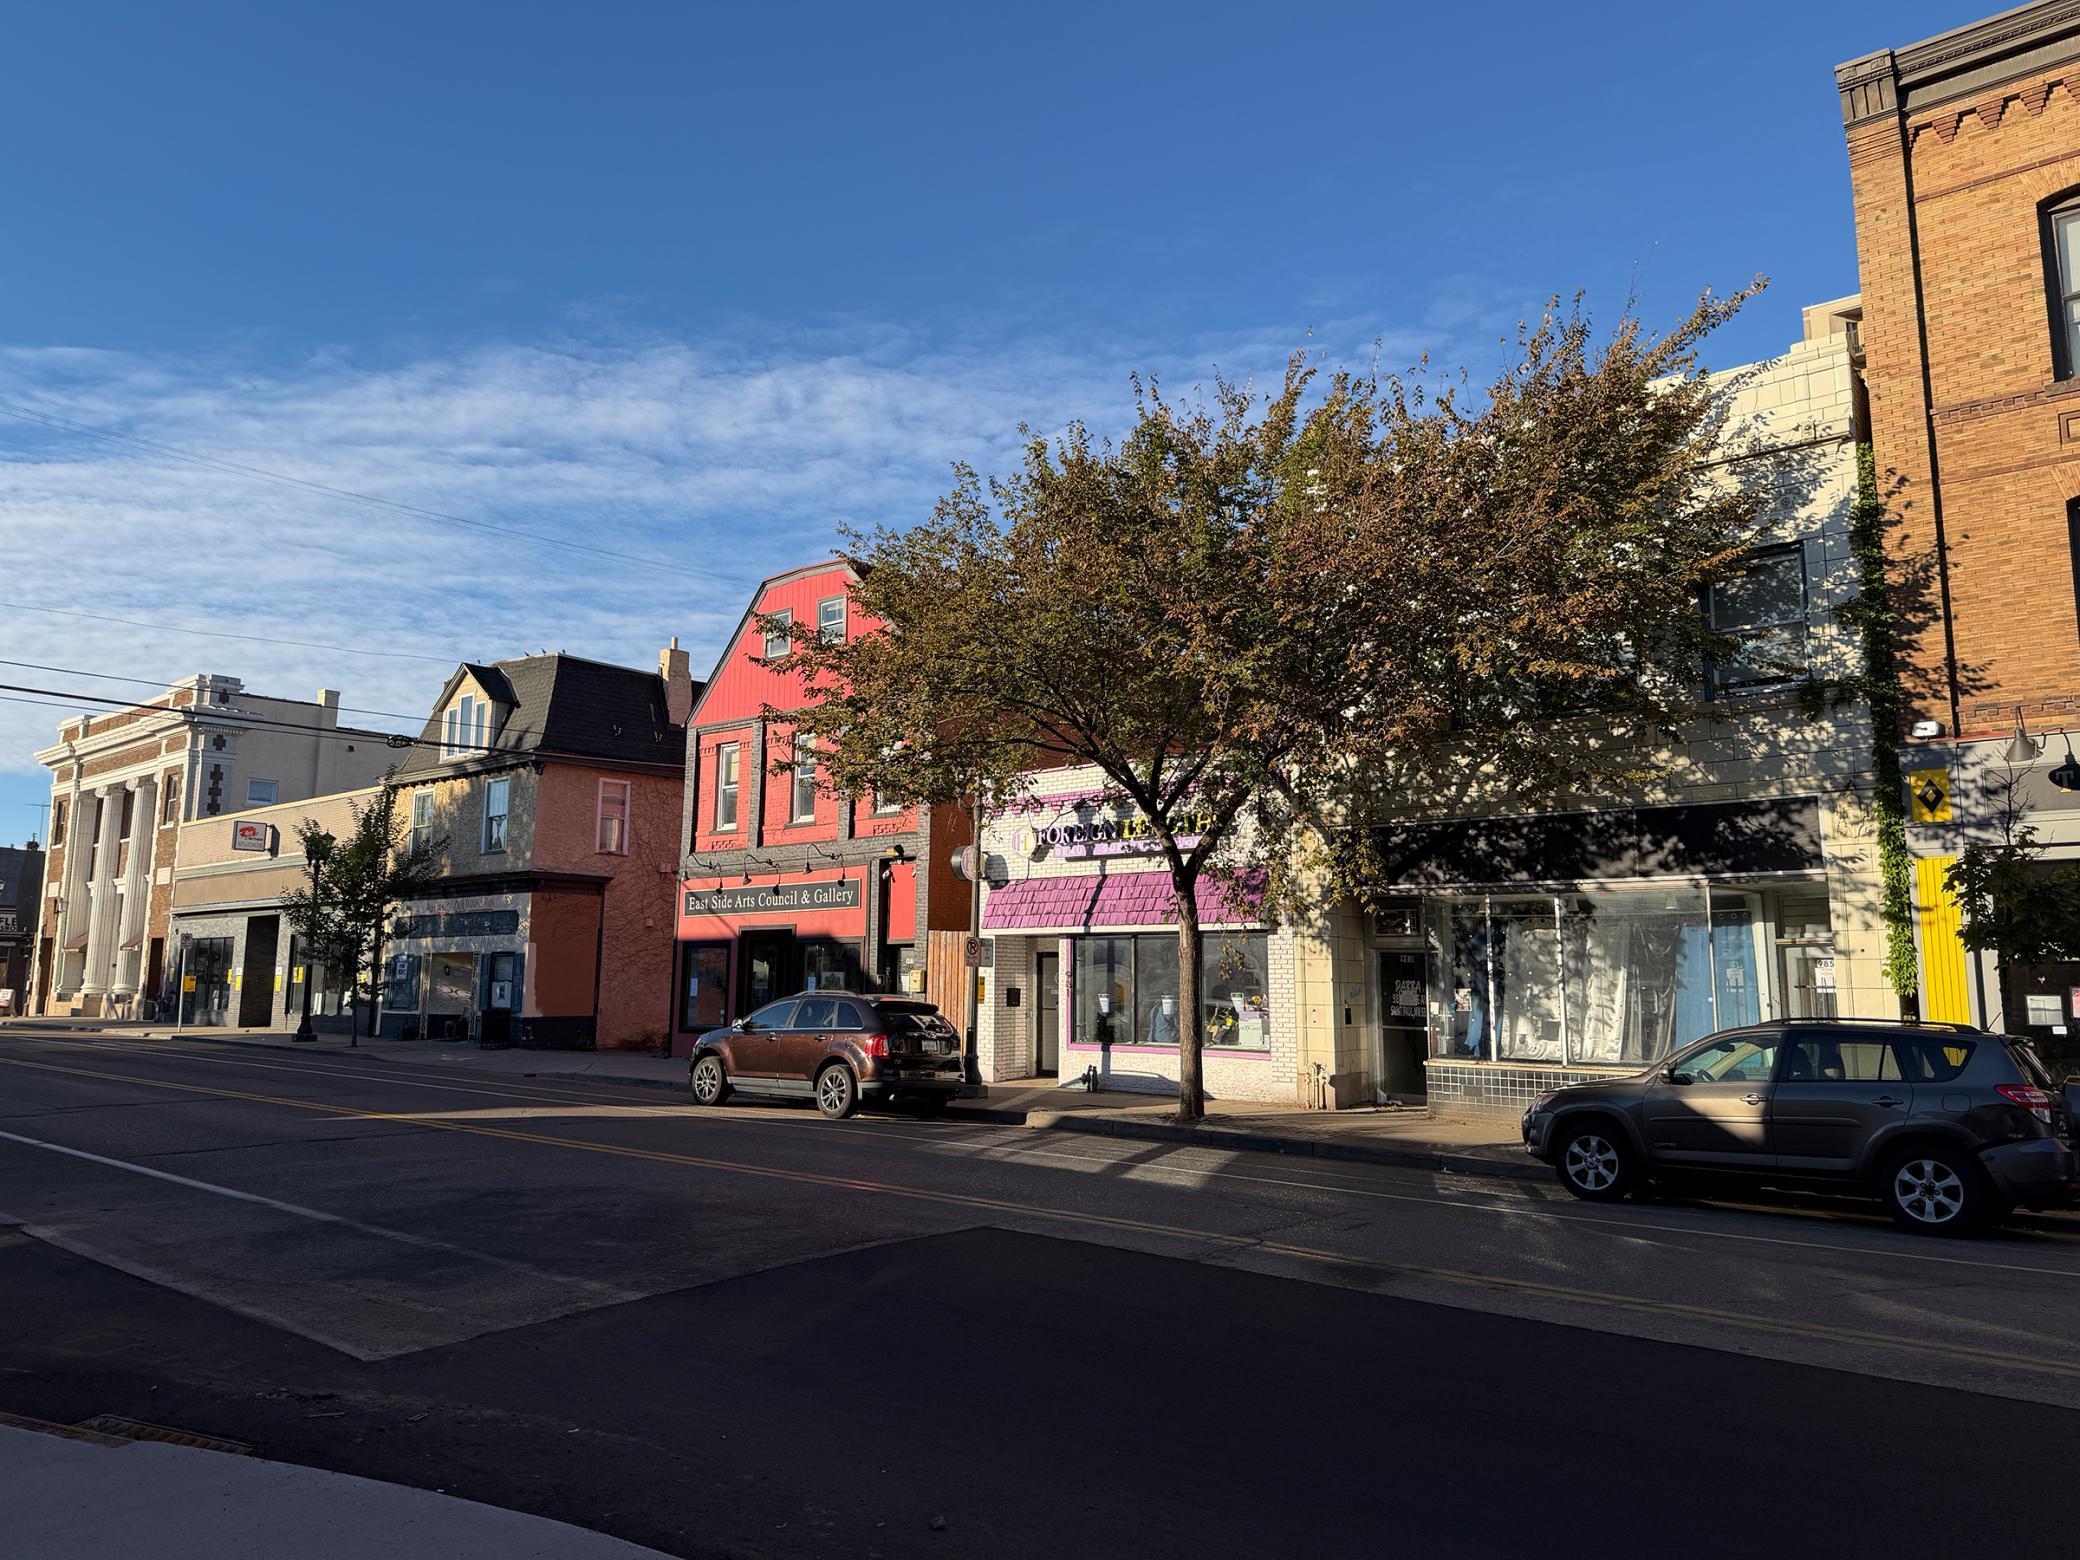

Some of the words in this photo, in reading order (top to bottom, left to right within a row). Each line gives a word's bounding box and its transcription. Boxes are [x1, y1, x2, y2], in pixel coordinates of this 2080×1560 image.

[1037, 821, 1117, 846] FOREIGN
[1122, 813, 1216, 839] LEGTH
[688, 895, 709, 911] East
[711, 894, 733, 909] Side
[734, 893, 755, 908] Arts
[758, 891, 798, 907] Council
[801, 890, 811, 904] &
[814, 888, 854, 905] Gallery
[1817, 960, 1835, 968] 985
